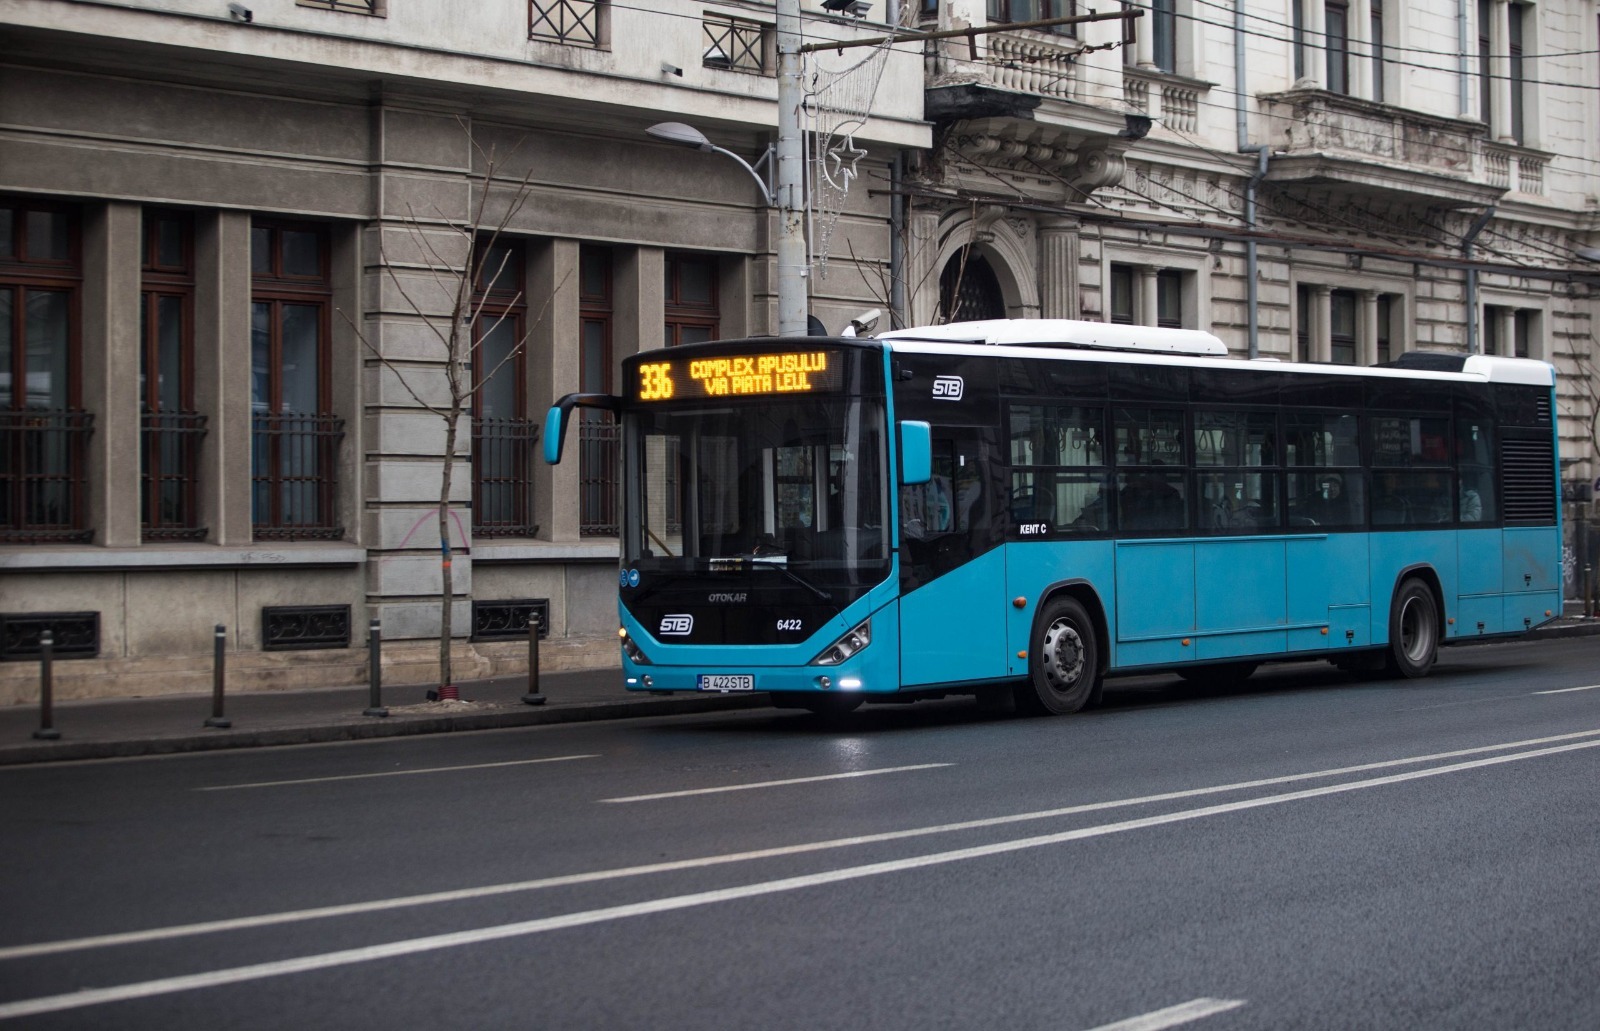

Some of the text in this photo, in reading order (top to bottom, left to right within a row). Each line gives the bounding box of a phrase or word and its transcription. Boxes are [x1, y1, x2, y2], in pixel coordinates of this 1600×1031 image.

[690, 352, 826, 379] COMPLEX APUSULUI
[639, 364, 673, 399] 336
[705, 378, 728, 395] VIA
[732, 373, 772, 393] PIATA
[932, 378, 962, 397] STB
[1020, 523, 1047, 534] KENT C
[708, 593, 747, 602] OTOKAR
[660, 616, 691, 633] STB
[777, 619, 801, 630] 6422
[703, 676, 750, 688] B 422STB
